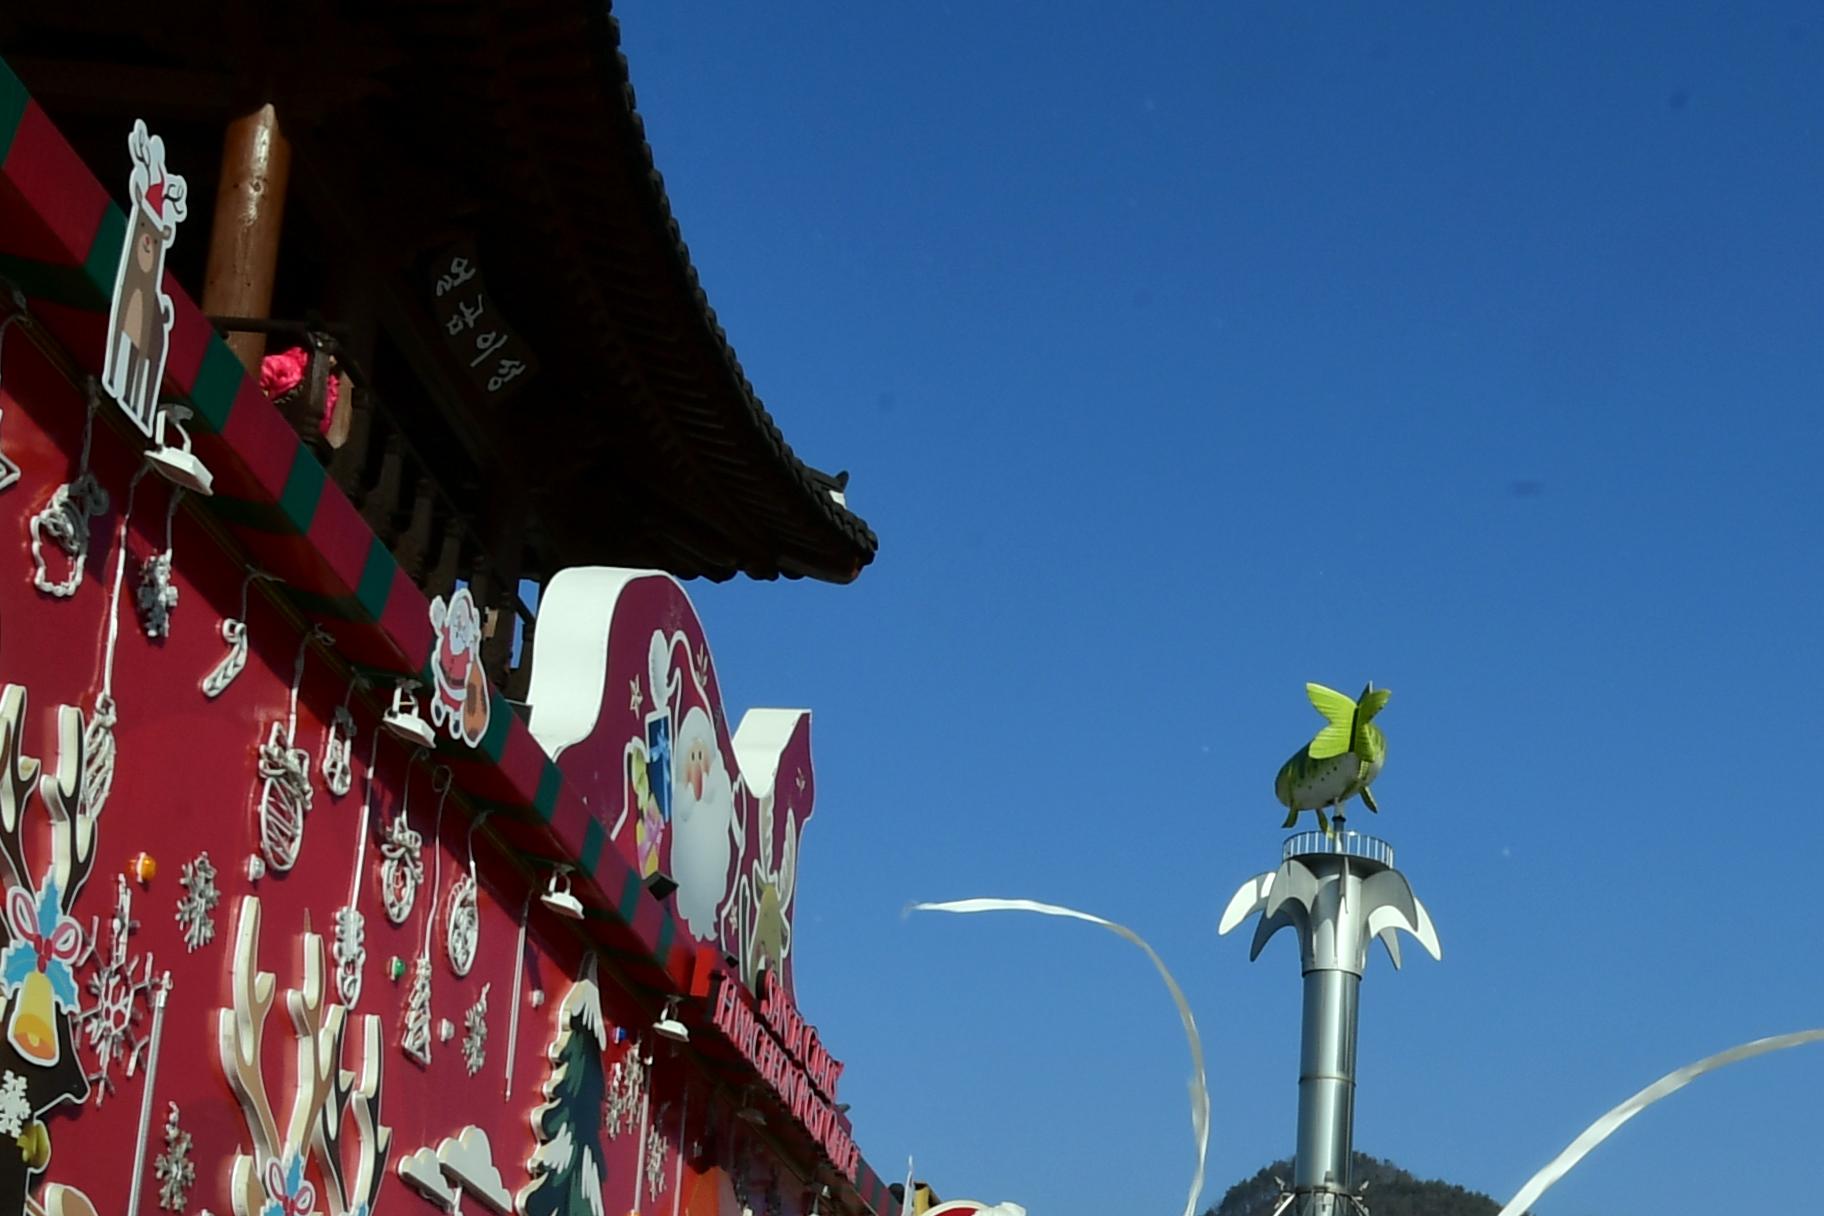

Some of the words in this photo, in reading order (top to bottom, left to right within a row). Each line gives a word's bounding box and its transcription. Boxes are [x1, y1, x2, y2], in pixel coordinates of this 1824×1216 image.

[712, 971, 796, 1107] HWACHEON
[791, 1068, 829, 1144] POST
[825, 1110, 861, 1184] OFFICE
[760, 968, 804, 1062] SANTA
